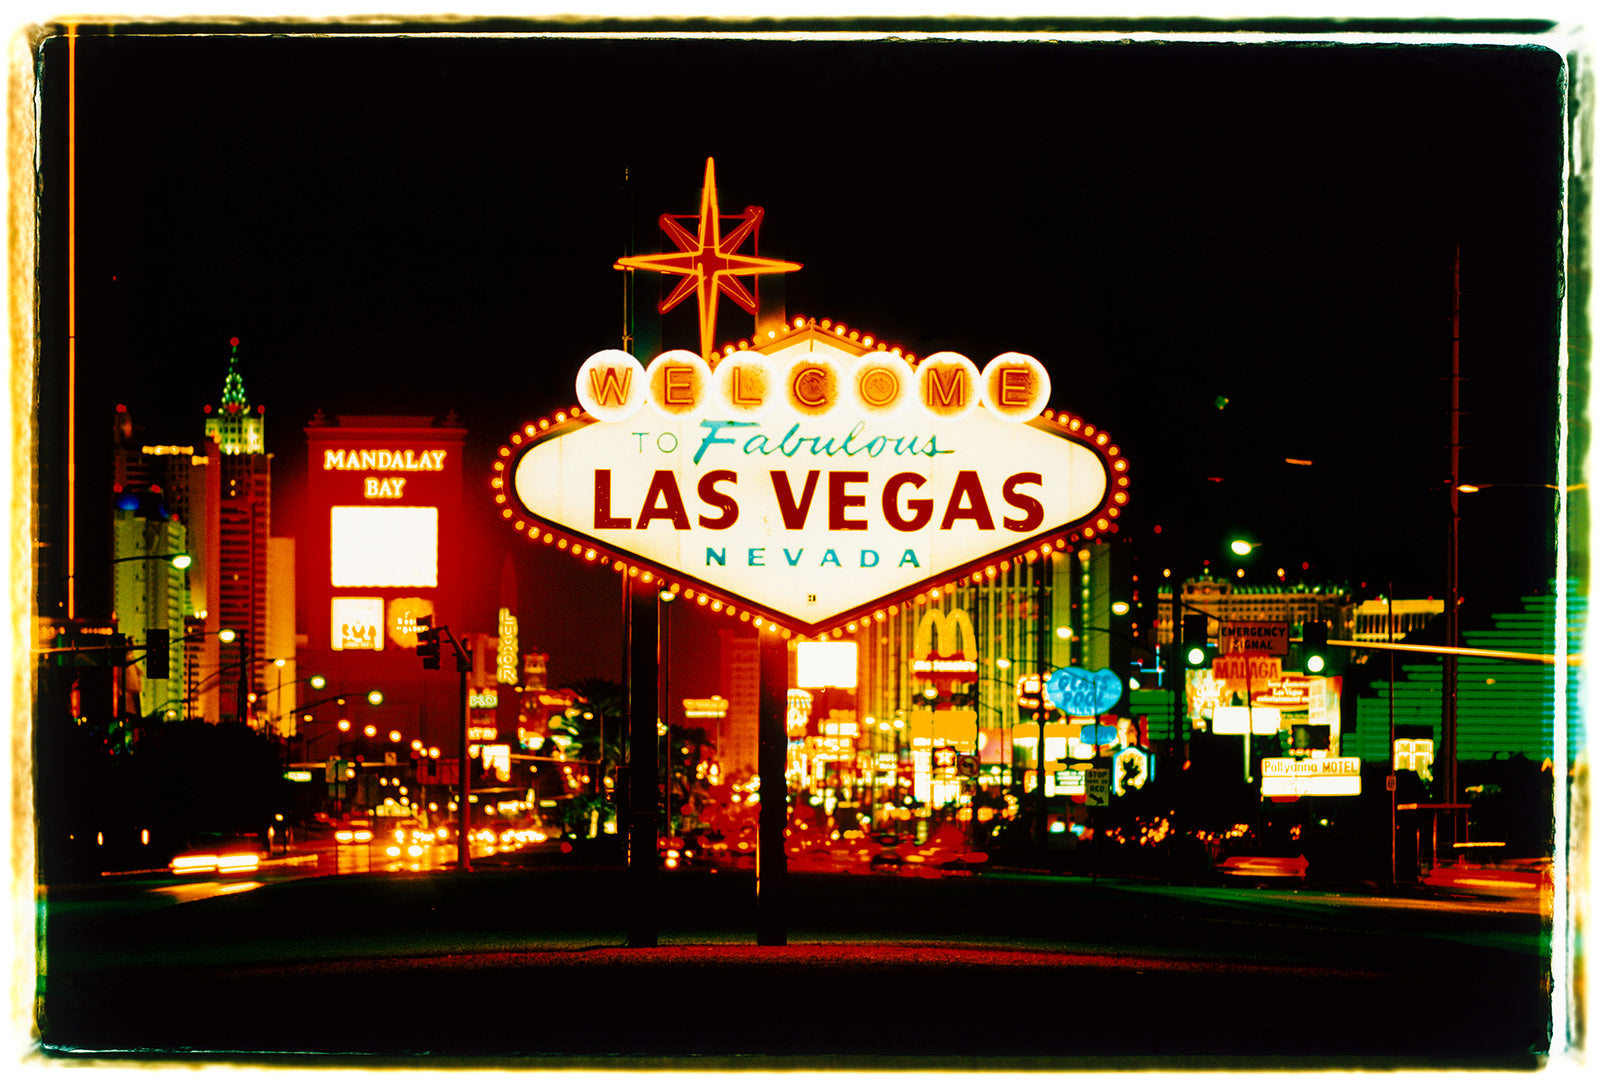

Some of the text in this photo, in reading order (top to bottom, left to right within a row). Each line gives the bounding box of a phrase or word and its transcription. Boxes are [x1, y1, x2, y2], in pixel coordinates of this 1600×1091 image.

[589, 366, 1030, 407] WELCOME
[632, 418, 956, 466] TO Fabulous
[324, 449, 447, 471] MANDALAY
[364, 477, 406, 499] BAY
[593, 469, 1046, 533] LAS VEGAS
[705, 547, 922, 569] NEVADA
[1221, 627, 1286, 637] EMERGENCY
[497, 607, 519, 685] LUXOR
[1233, 639, 1274, 650] SIGNAL
[1214, 661, 1279, 679] MALAGA
[1273, 687, 1303, 697] Las Vegas
[1264, 760, 1358, 773] Pollyanna MOTEL
